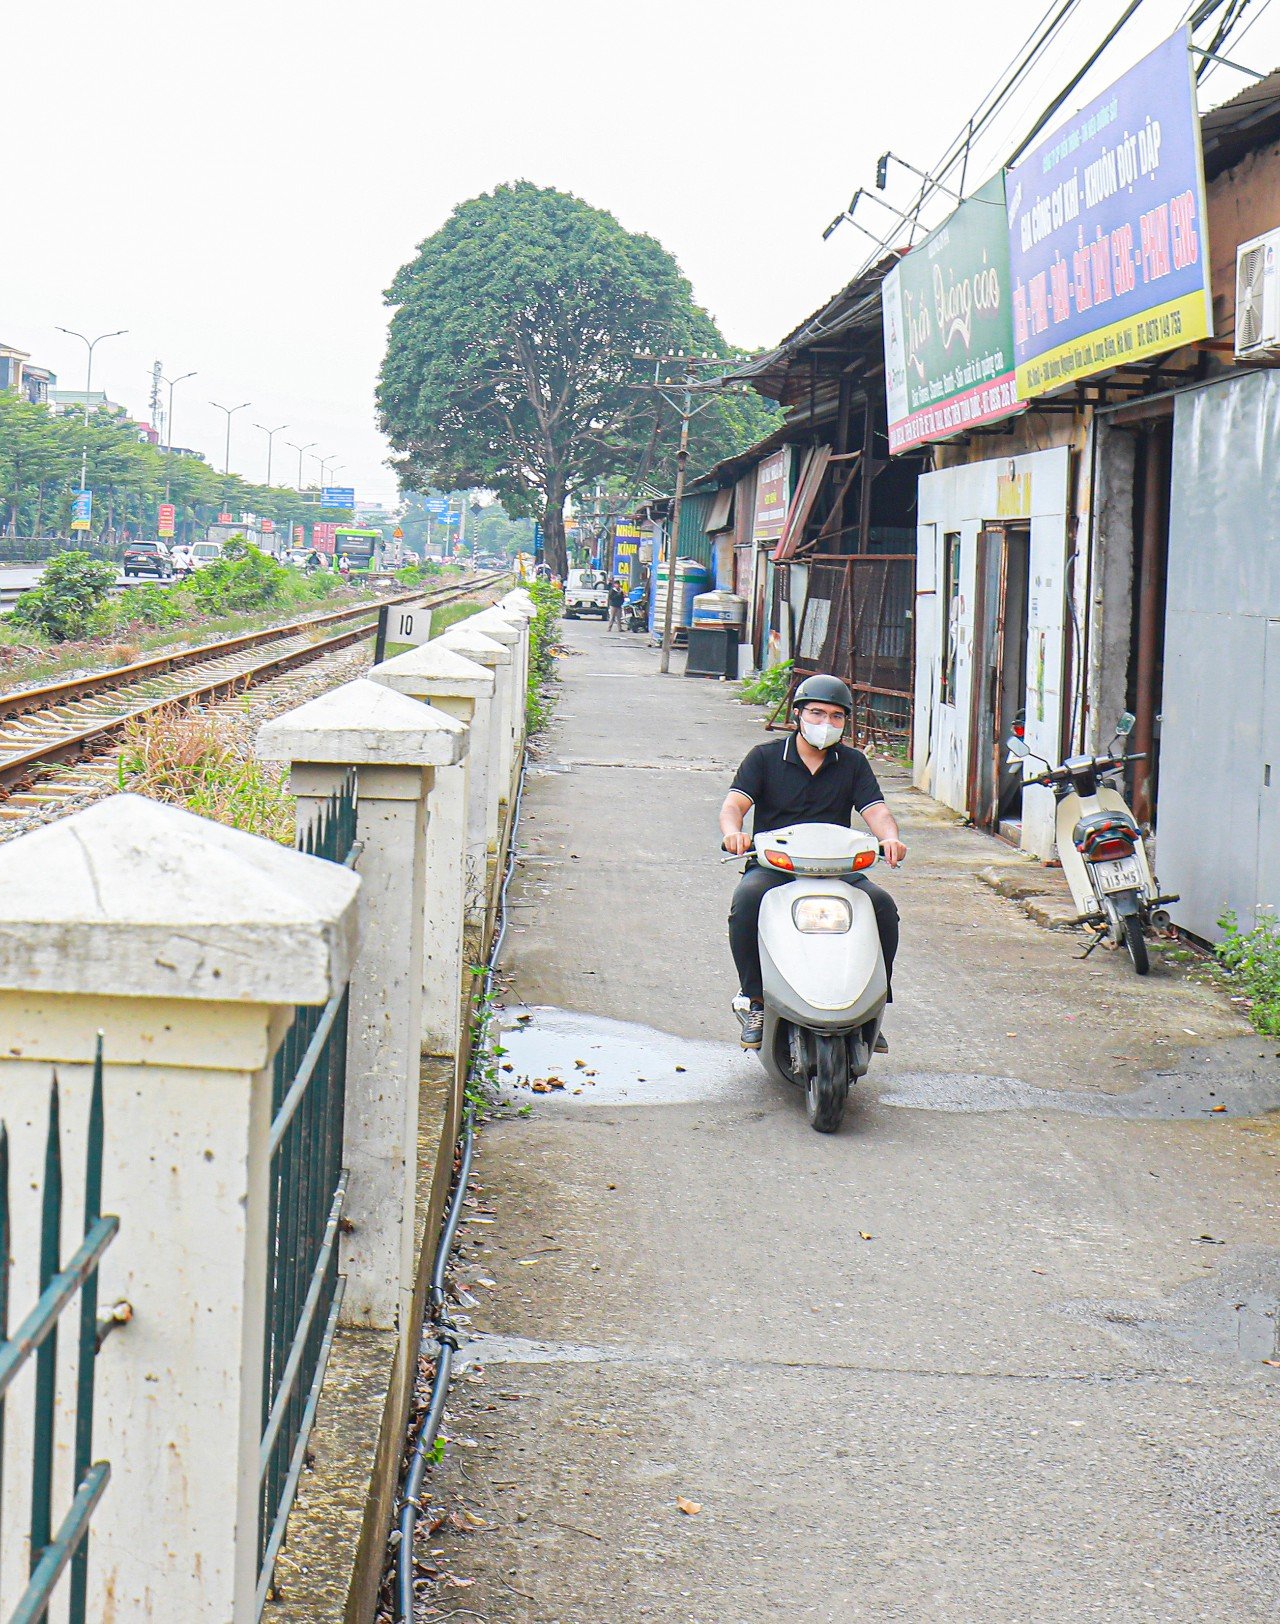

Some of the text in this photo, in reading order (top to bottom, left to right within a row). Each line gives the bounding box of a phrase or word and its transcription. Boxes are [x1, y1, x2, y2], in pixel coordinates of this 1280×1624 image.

[1031, 195, 1053, 245] CÔNG
[1063, 166, 1081, 223] KHÍ
[1084, 146, 1118, 209] KHUÔN
[1116, 130, 1138, 194] ĐỘT
[1138, 115, 1162, 181] DẬP
[1111, 222, 1136, 297] CNC
[1139, 202, 1171, 284] PHAY
[1170, 189, 1198, 271] CNC
[973, 248, 1001, 310] cáo
[617, 541, 638, 556] KÍNH
[399, 614, 413, 636] 10
[1111, 861, 1123, 873] 31
